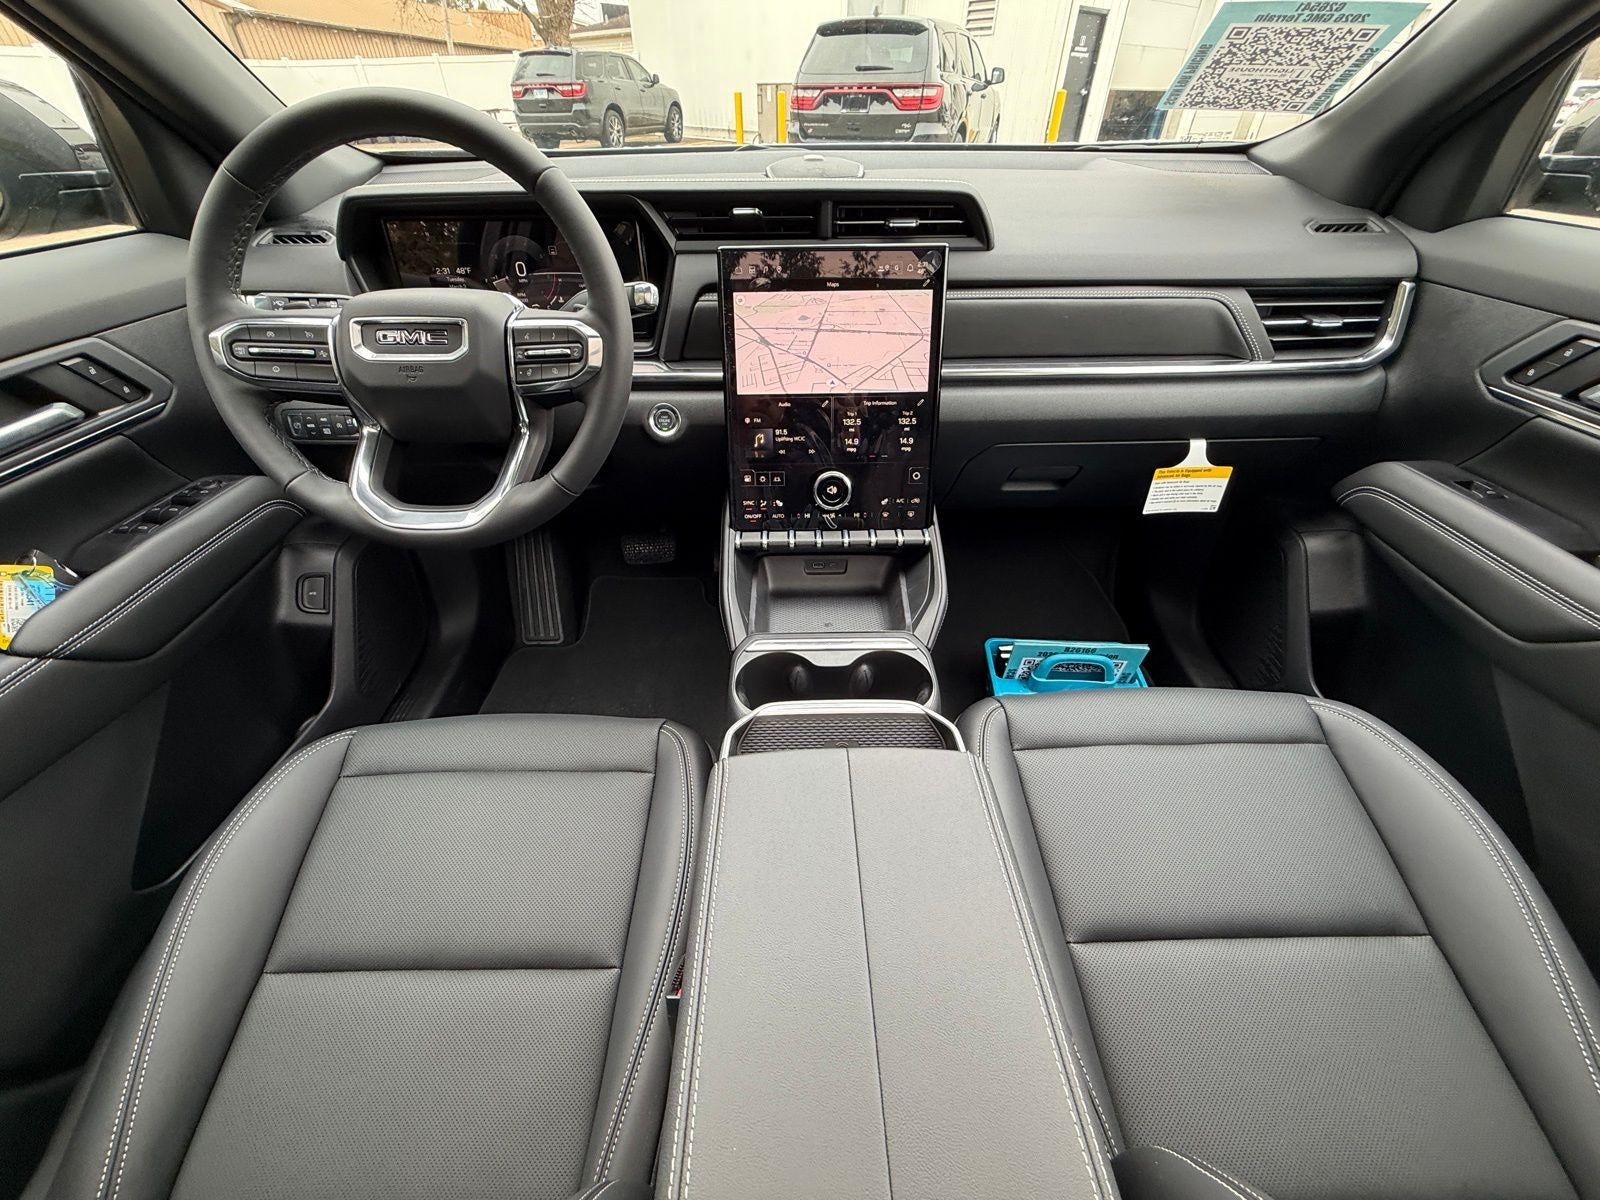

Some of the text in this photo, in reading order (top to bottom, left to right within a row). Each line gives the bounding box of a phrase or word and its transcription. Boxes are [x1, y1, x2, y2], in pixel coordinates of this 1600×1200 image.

[435, 267, 451, 275] 2:31
[515, 261, 527, 277] 0
[375, 329, 448, 345] GMC
[842, 418, 862, 426] 132.5
[898, 417, 917, 425] 132.5
[775, 428, 788, 436] 91.5
[844, 437, 859, 446] 14.9
[899, 437, 914, 445] 14.9
